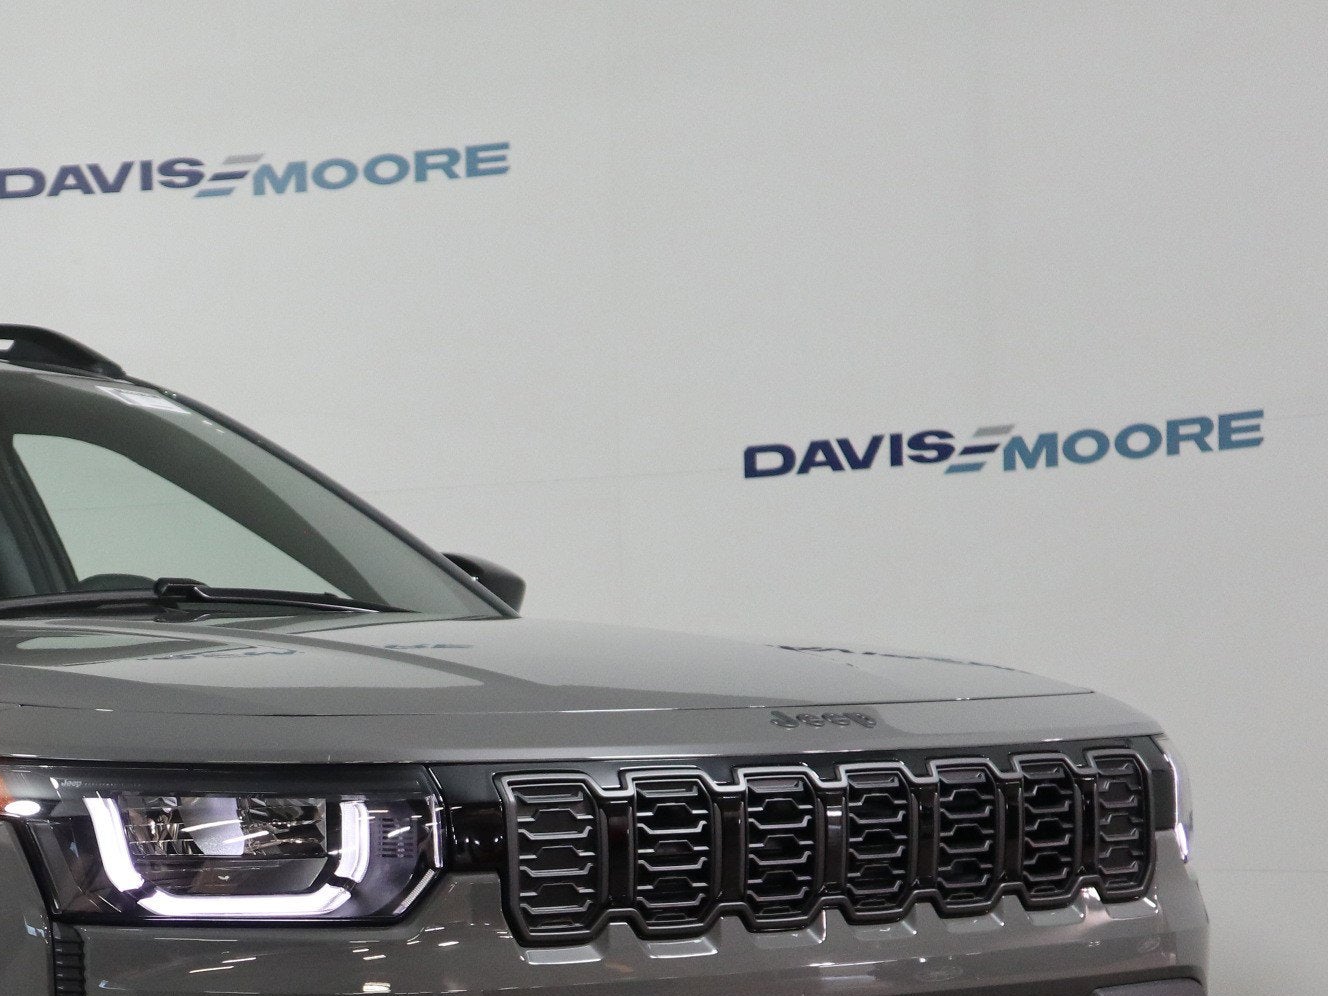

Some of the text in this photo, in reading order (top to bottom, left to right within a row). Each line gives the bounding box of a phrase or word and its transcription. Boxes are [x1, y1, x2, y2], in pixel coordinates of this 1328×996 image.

[252, 142, 510, 196] MOORE
[744, 409, 1264, 479] DAVIS MOORE
[770, 710, 877, 729] Jeep
